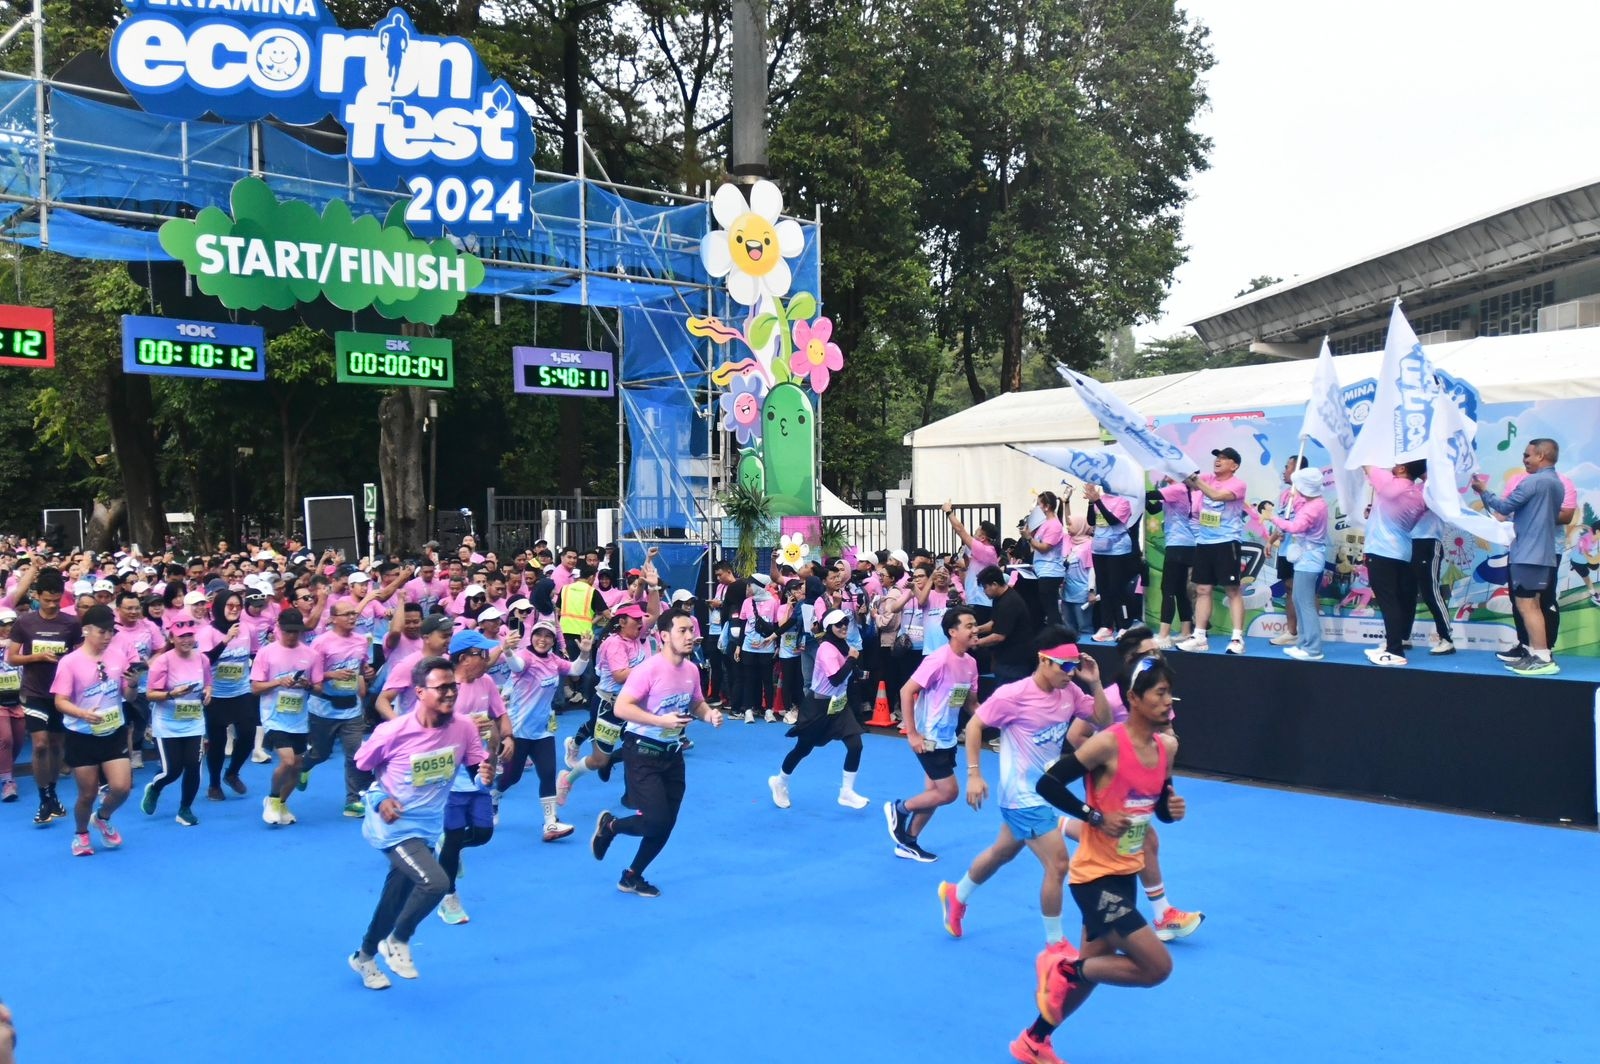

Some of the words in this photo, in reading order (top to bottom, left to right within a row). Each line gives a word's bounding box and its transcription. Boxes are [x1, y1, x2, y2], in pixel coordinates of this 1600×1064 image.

[117, 19, 311, 92] eco
[319, 33, 473, 100] run
[346, 84, 515, 161] fest
[405, 176, 523, 222] 2024
[195, 233, 466, 292] START/FINISH
[176, 323, 216, 338] 10K
[385, 339, 410, 352] 5K
[550, 351, 581, 364] 1,5K
[350, 351, 443, 378] 00:00:04
[539, 366, 607, 388] 5:40:11
[413, 754, 454, 773] 50594
